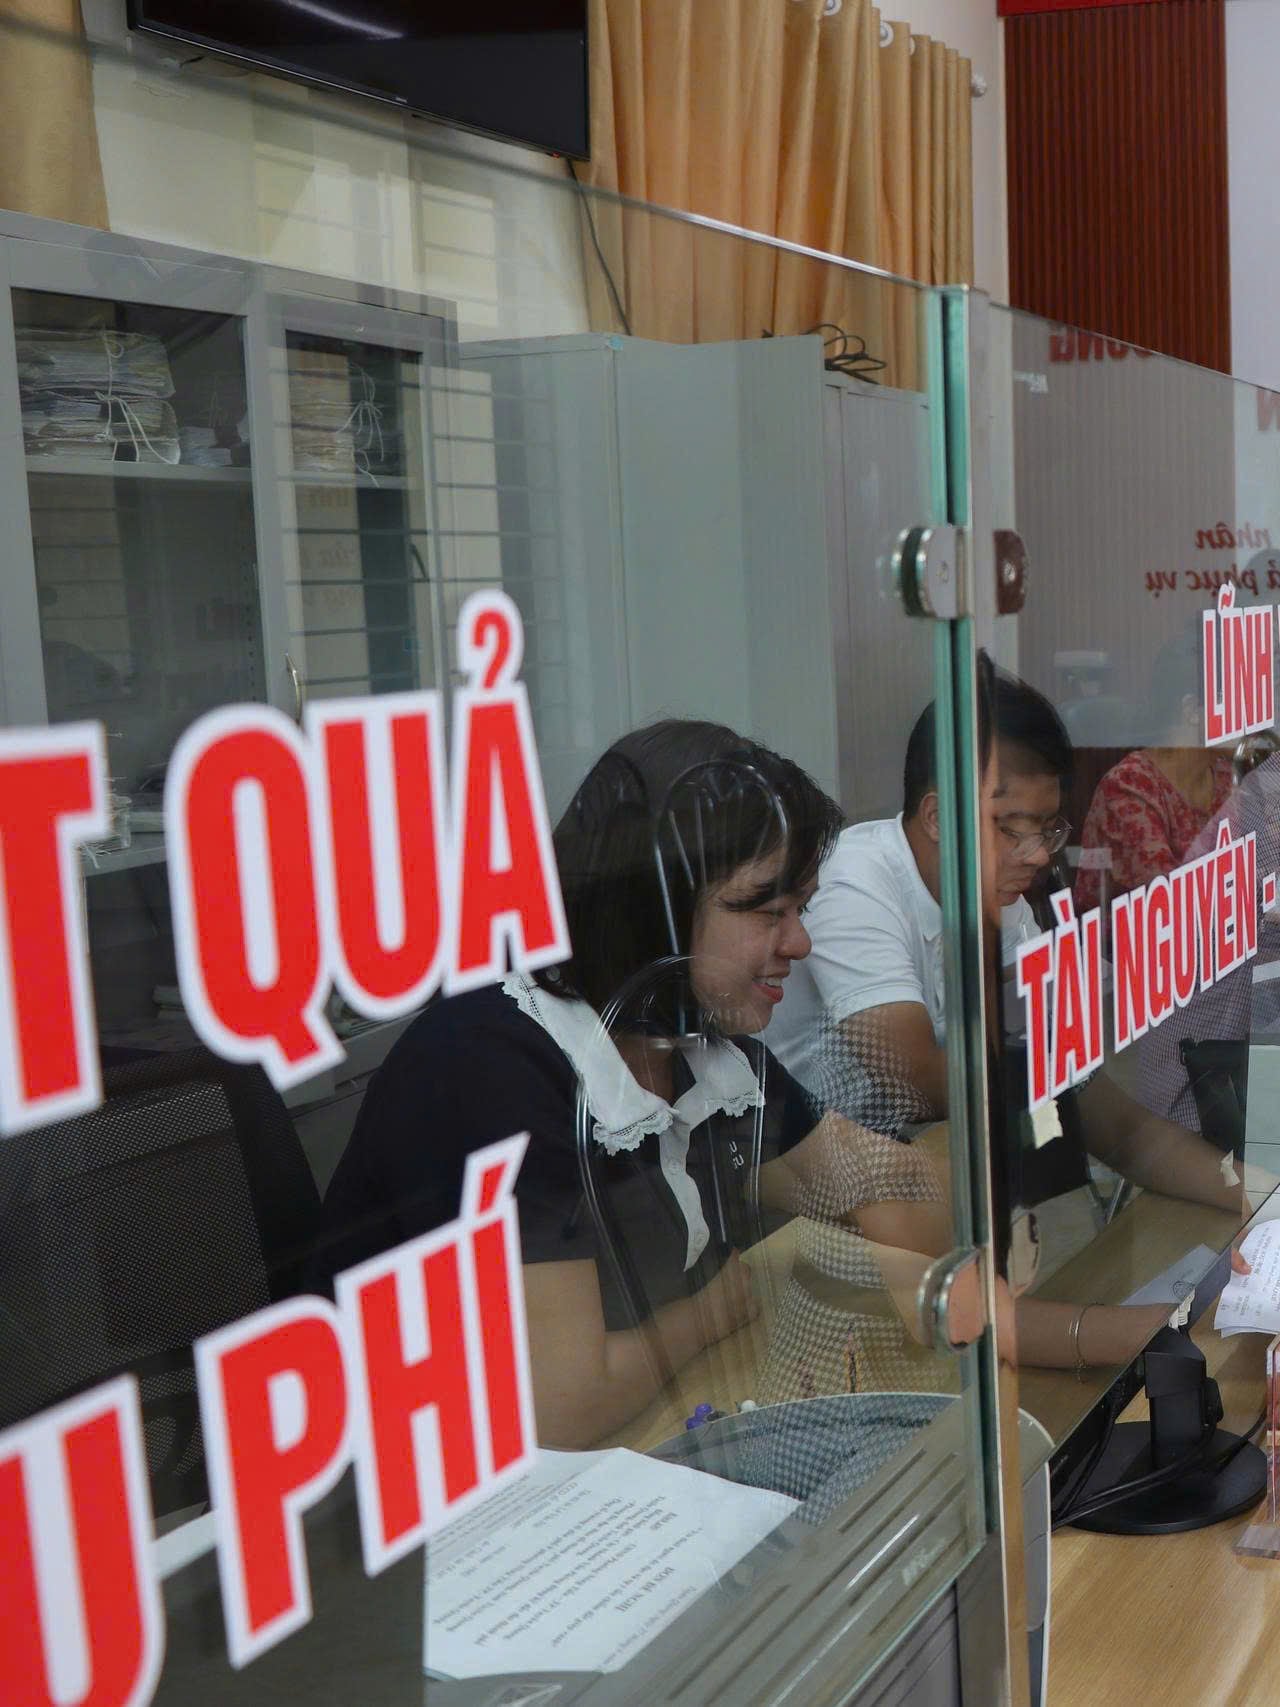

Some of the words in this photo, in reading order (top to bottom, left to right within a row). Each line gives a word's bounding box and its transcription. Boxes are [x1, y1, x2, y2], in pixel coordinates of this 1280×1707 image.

[170, 593, 568, 1085] QUẢ
[1204, 583, 1274, 745] LĨNH
[1018, 890, 1104, 1110] TÀI
[1113, 820, 1257, 1052] NGUYÊN
[200, 1138, 534, 1660] PHÍ
